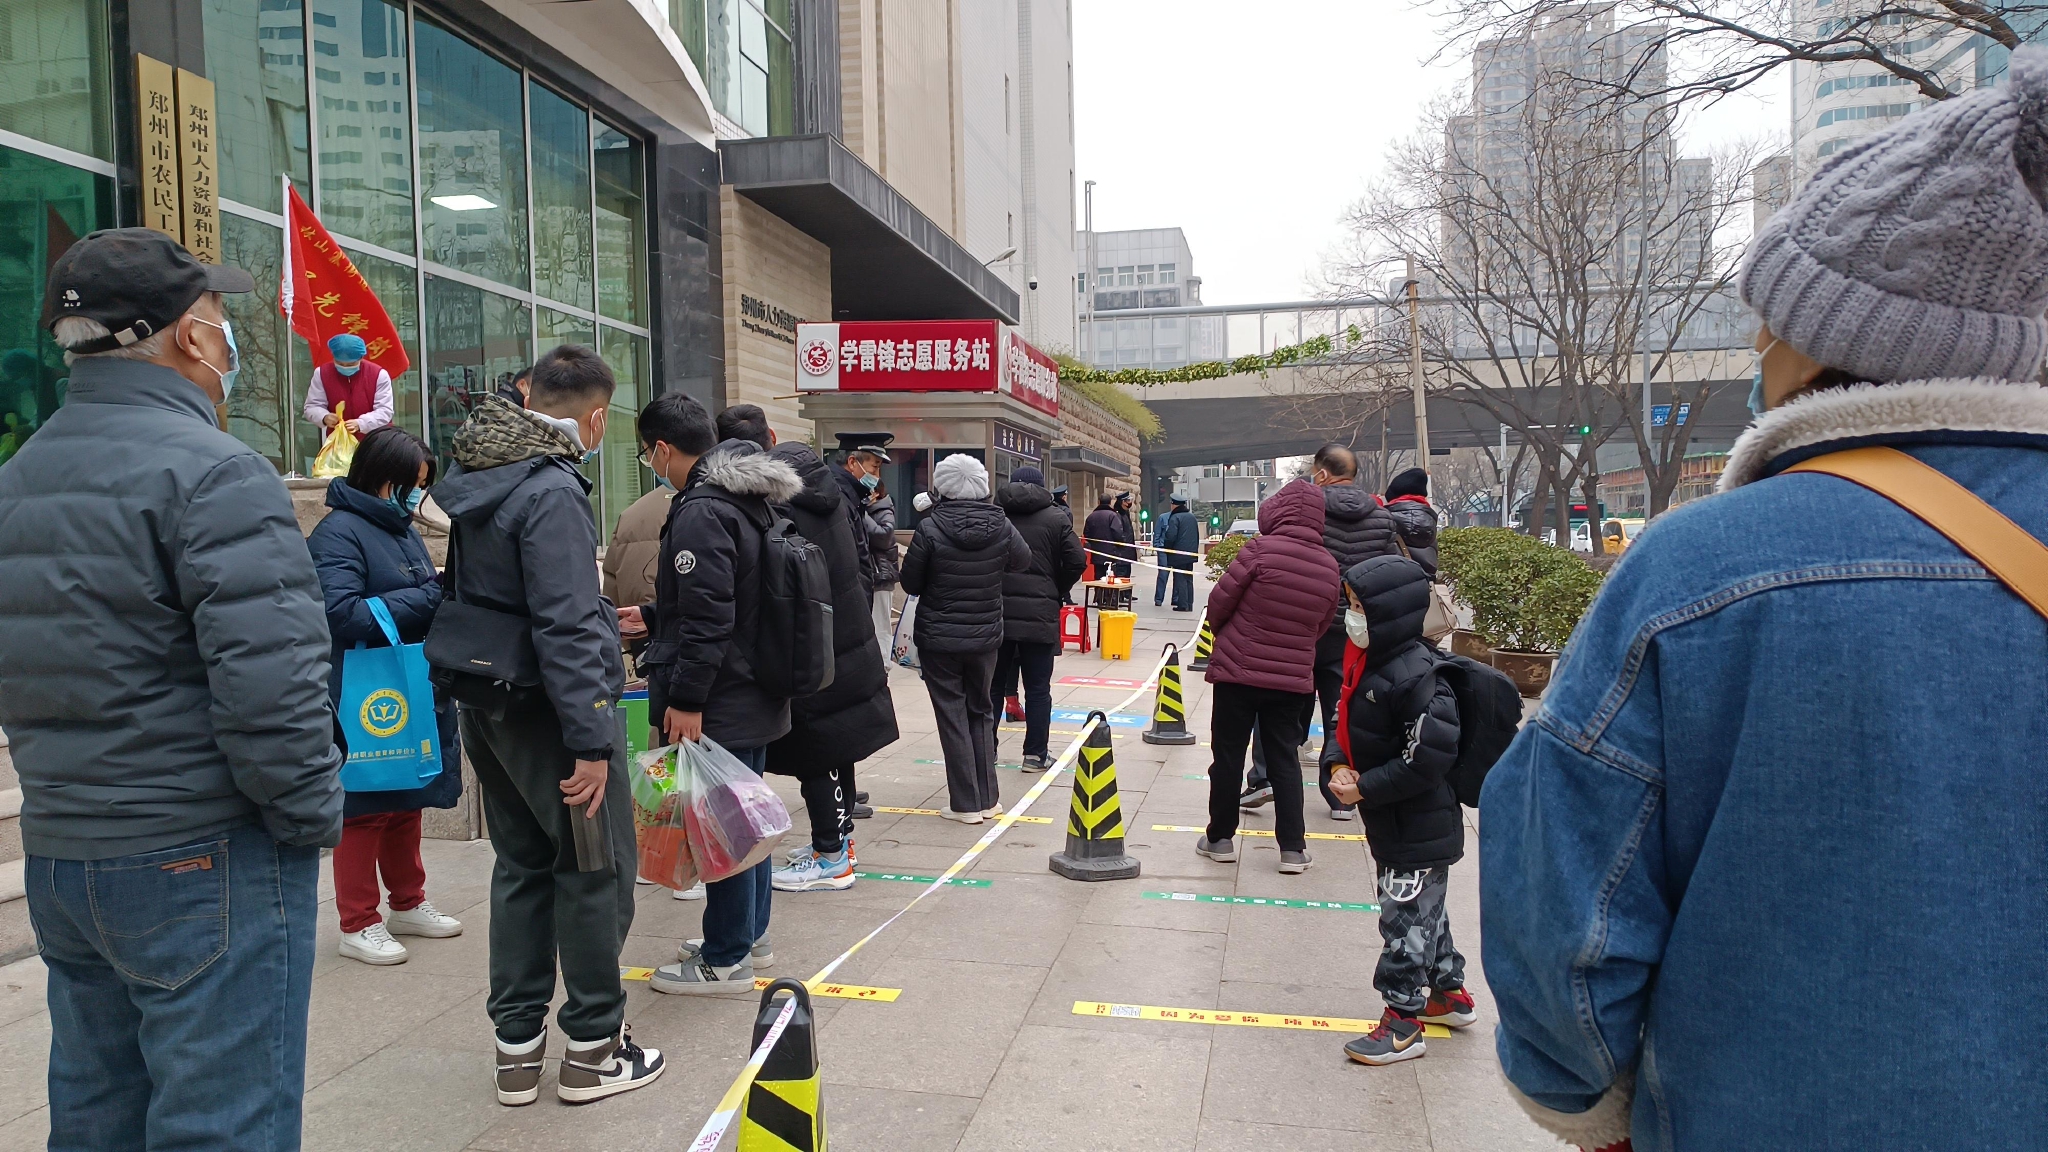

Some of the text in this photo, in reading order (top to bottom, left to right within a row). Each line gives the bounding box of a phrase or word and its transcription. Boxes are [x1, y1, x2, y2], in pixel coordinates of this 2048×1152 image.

[148, 90, 174, 232] 郑州市农民工
[188, 103, 214, 264] 郑州市人力资源和社会
[304, 270, 393, 360] 先锋岗
[741, 293, 805, 333] 郑州市人力资源
[840, 338, 991, 373] 学雷锋志愿服务站
